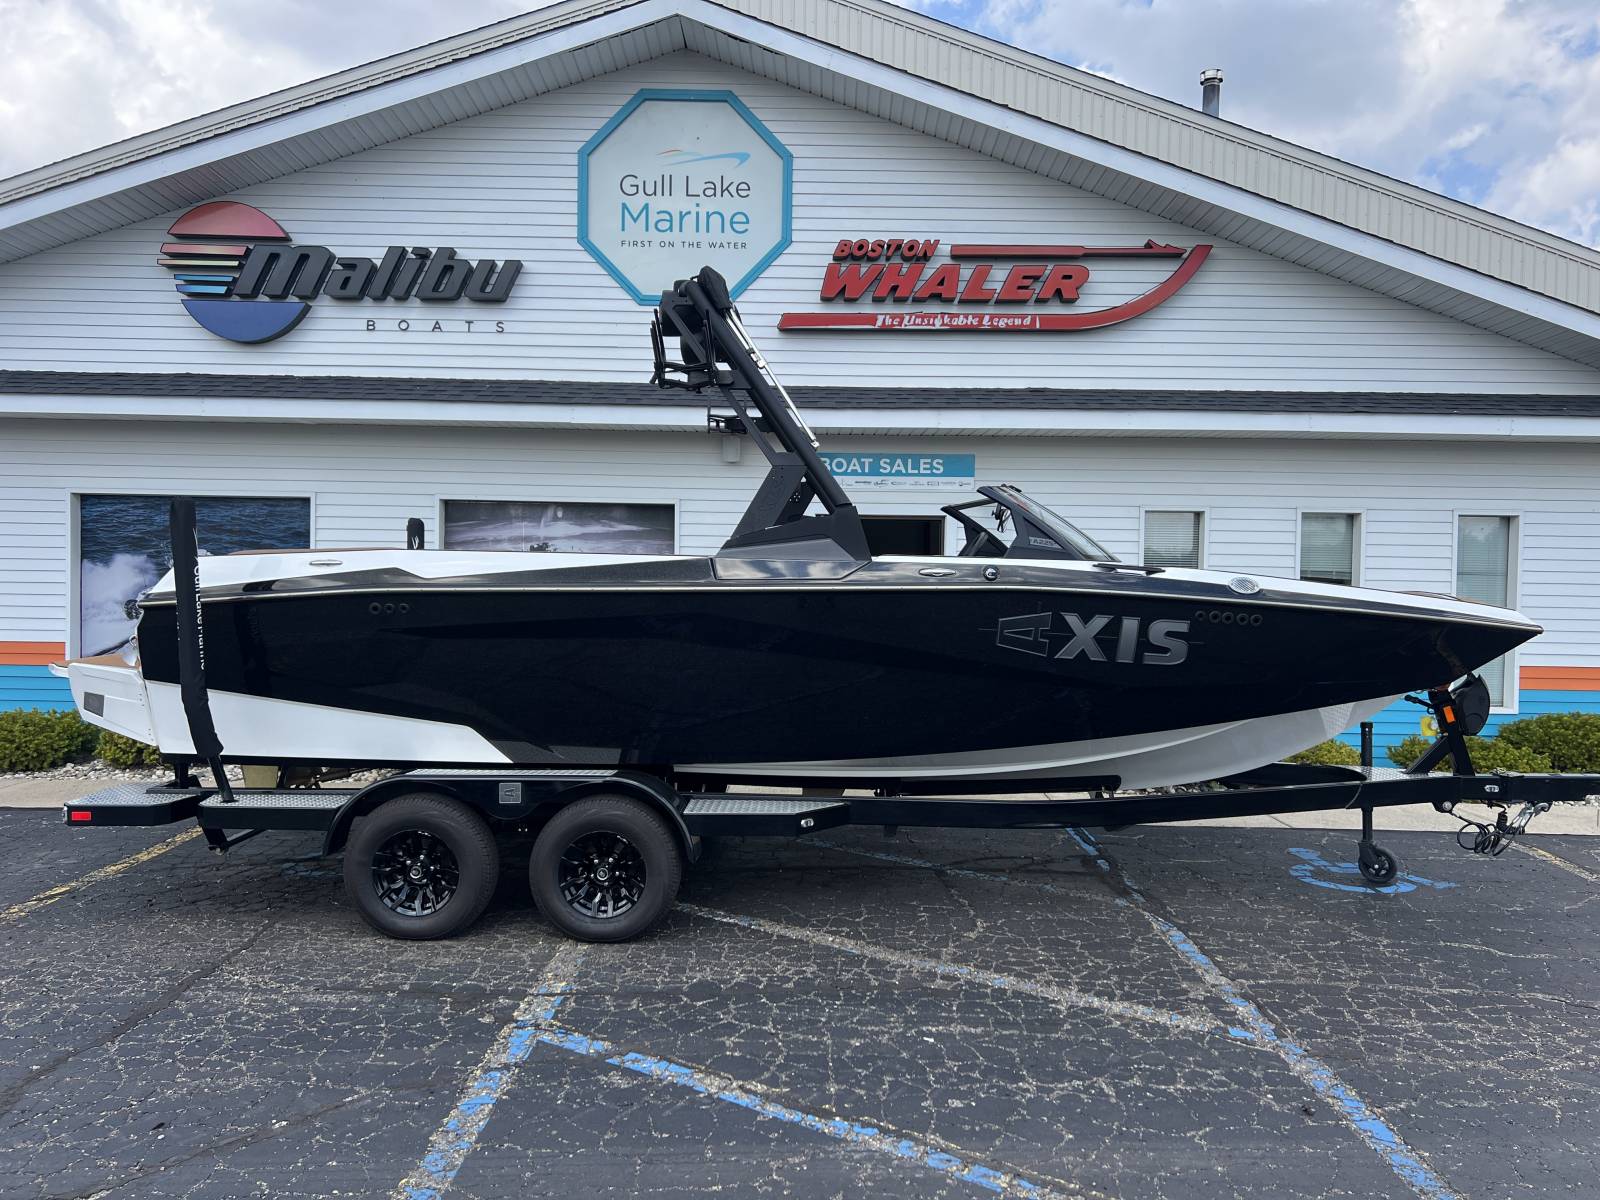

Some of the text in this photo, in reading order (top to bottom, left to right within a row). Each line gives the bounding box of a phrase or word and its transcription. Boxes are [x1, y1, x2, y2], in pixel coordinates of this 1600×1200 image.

[620, 174, 751, 198] Gull Lake
[620, 202, 750, 235] Marine
[620, 240, 747, 250] FIRST ON THE WATER
[833, 238, 940, 262] BOSTON
[233, 244, 524, 302] Malibu
[820, 263, 1090, 304] WHALER
[366, 319, 505, 334] BOATS
[875, 314, 901, 328] The
[982, 314, 1032, 328] Legend
[879, 458, 944, 474] SALES
